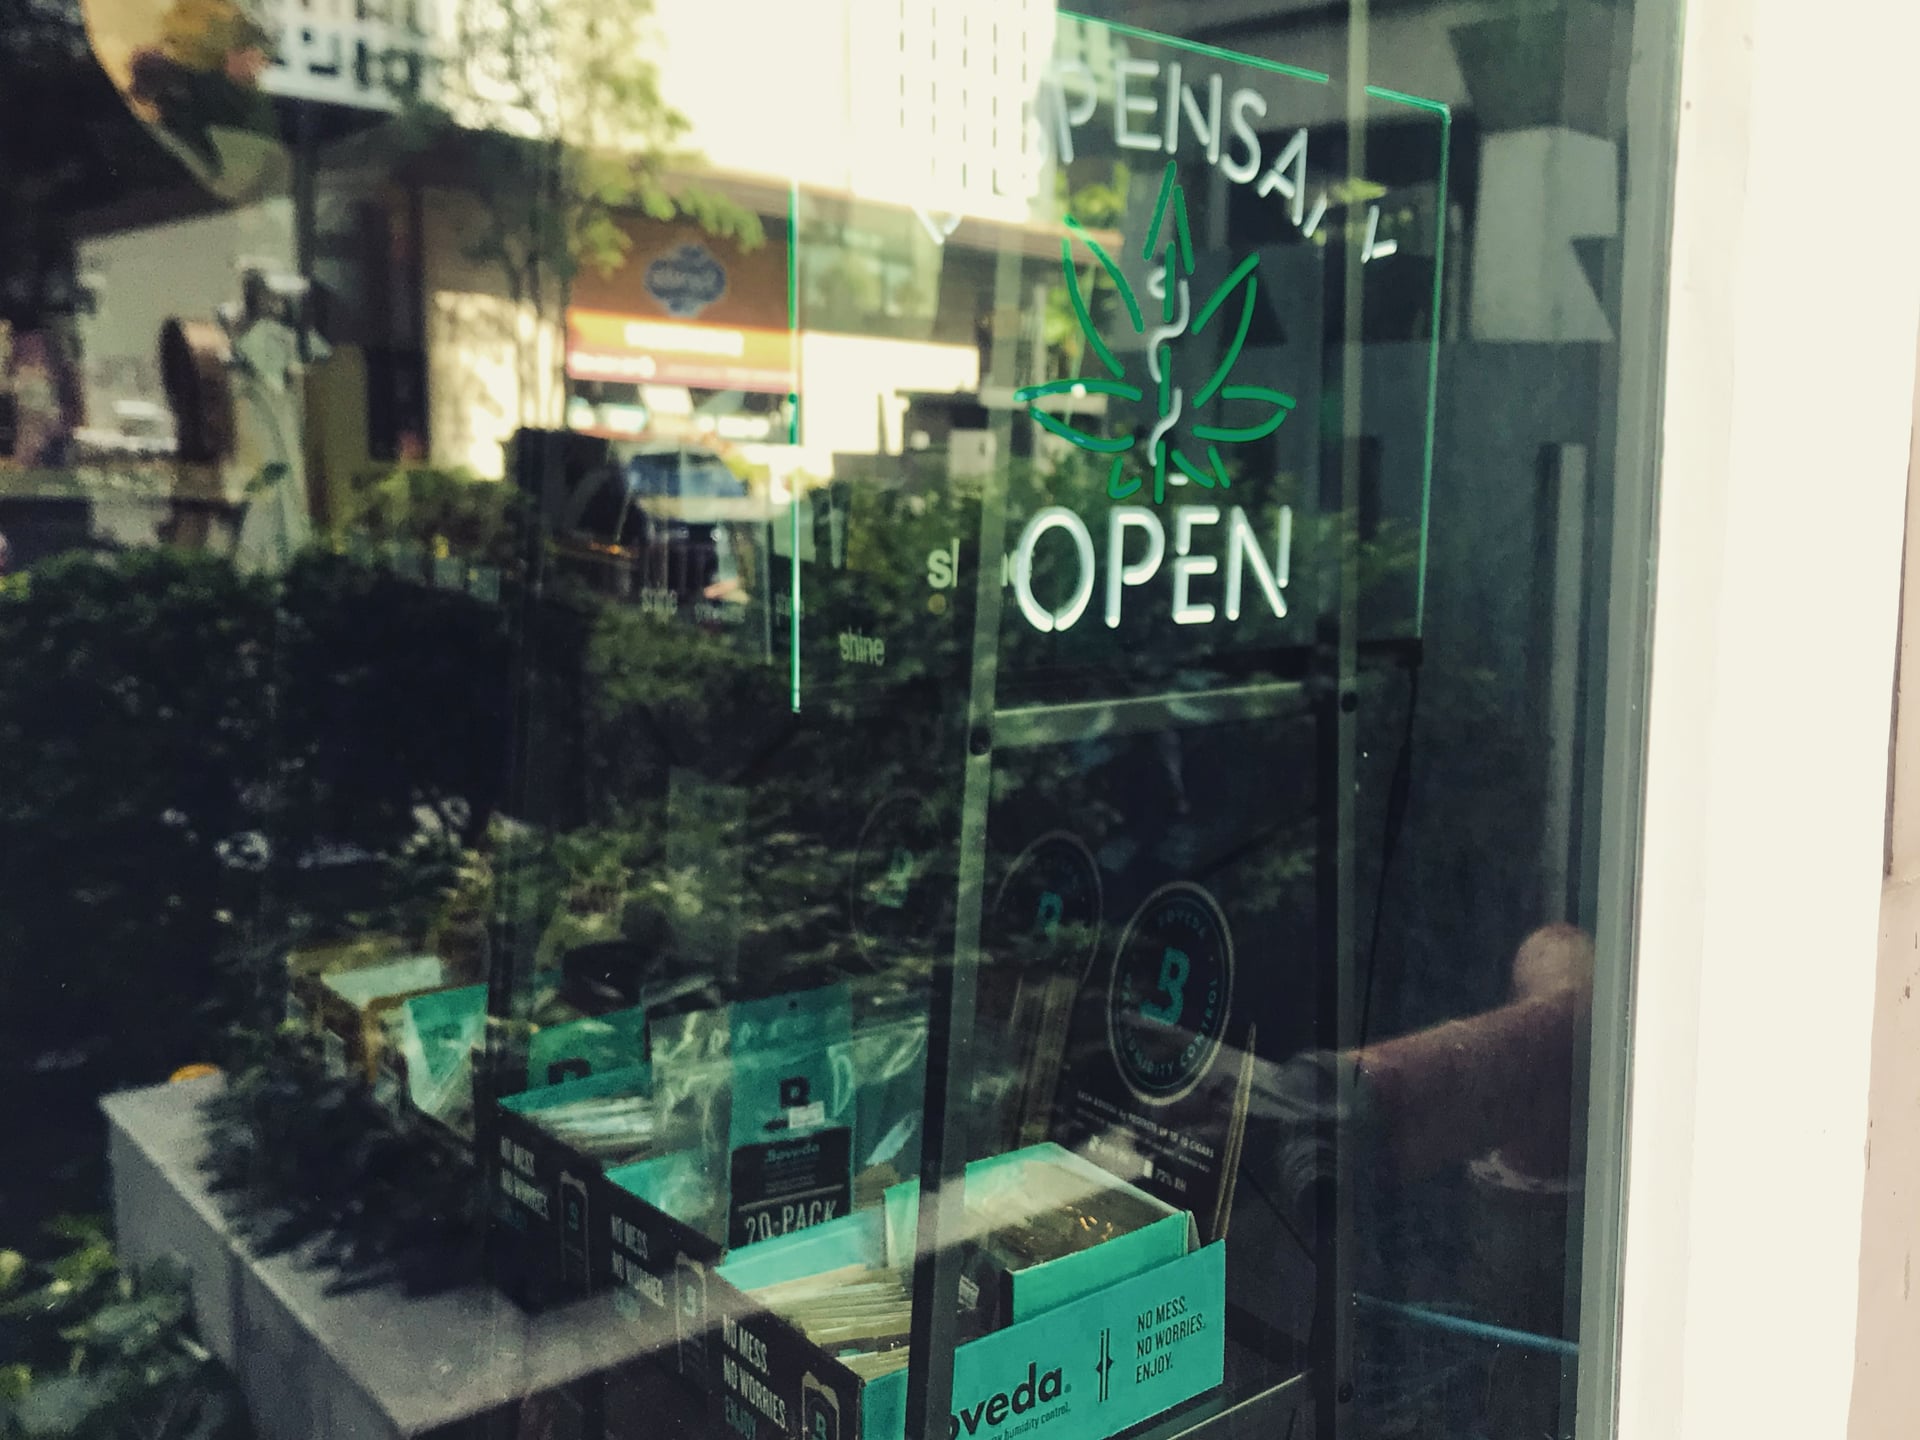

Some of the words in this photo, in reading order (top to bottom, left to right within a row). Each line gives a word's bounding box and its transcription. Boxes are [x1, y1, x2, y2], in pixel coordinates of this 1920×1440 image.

[1017, 505, 1293, 632] OPEN
[839, 627, 886, 667] shine
[723, 1313, 737, 1349] NO
[1137, 1309, 1153, 1333] NO
[1155, 1295, 1188, 1325] MESS.
[1136, 1335, 1152, 1360] NO
[1154, 1312, 1207, 1351] WORRIES.
[723, 1353, 738, 1390] NO
[1135, 1351, 1174, 1385] ENJOY.
